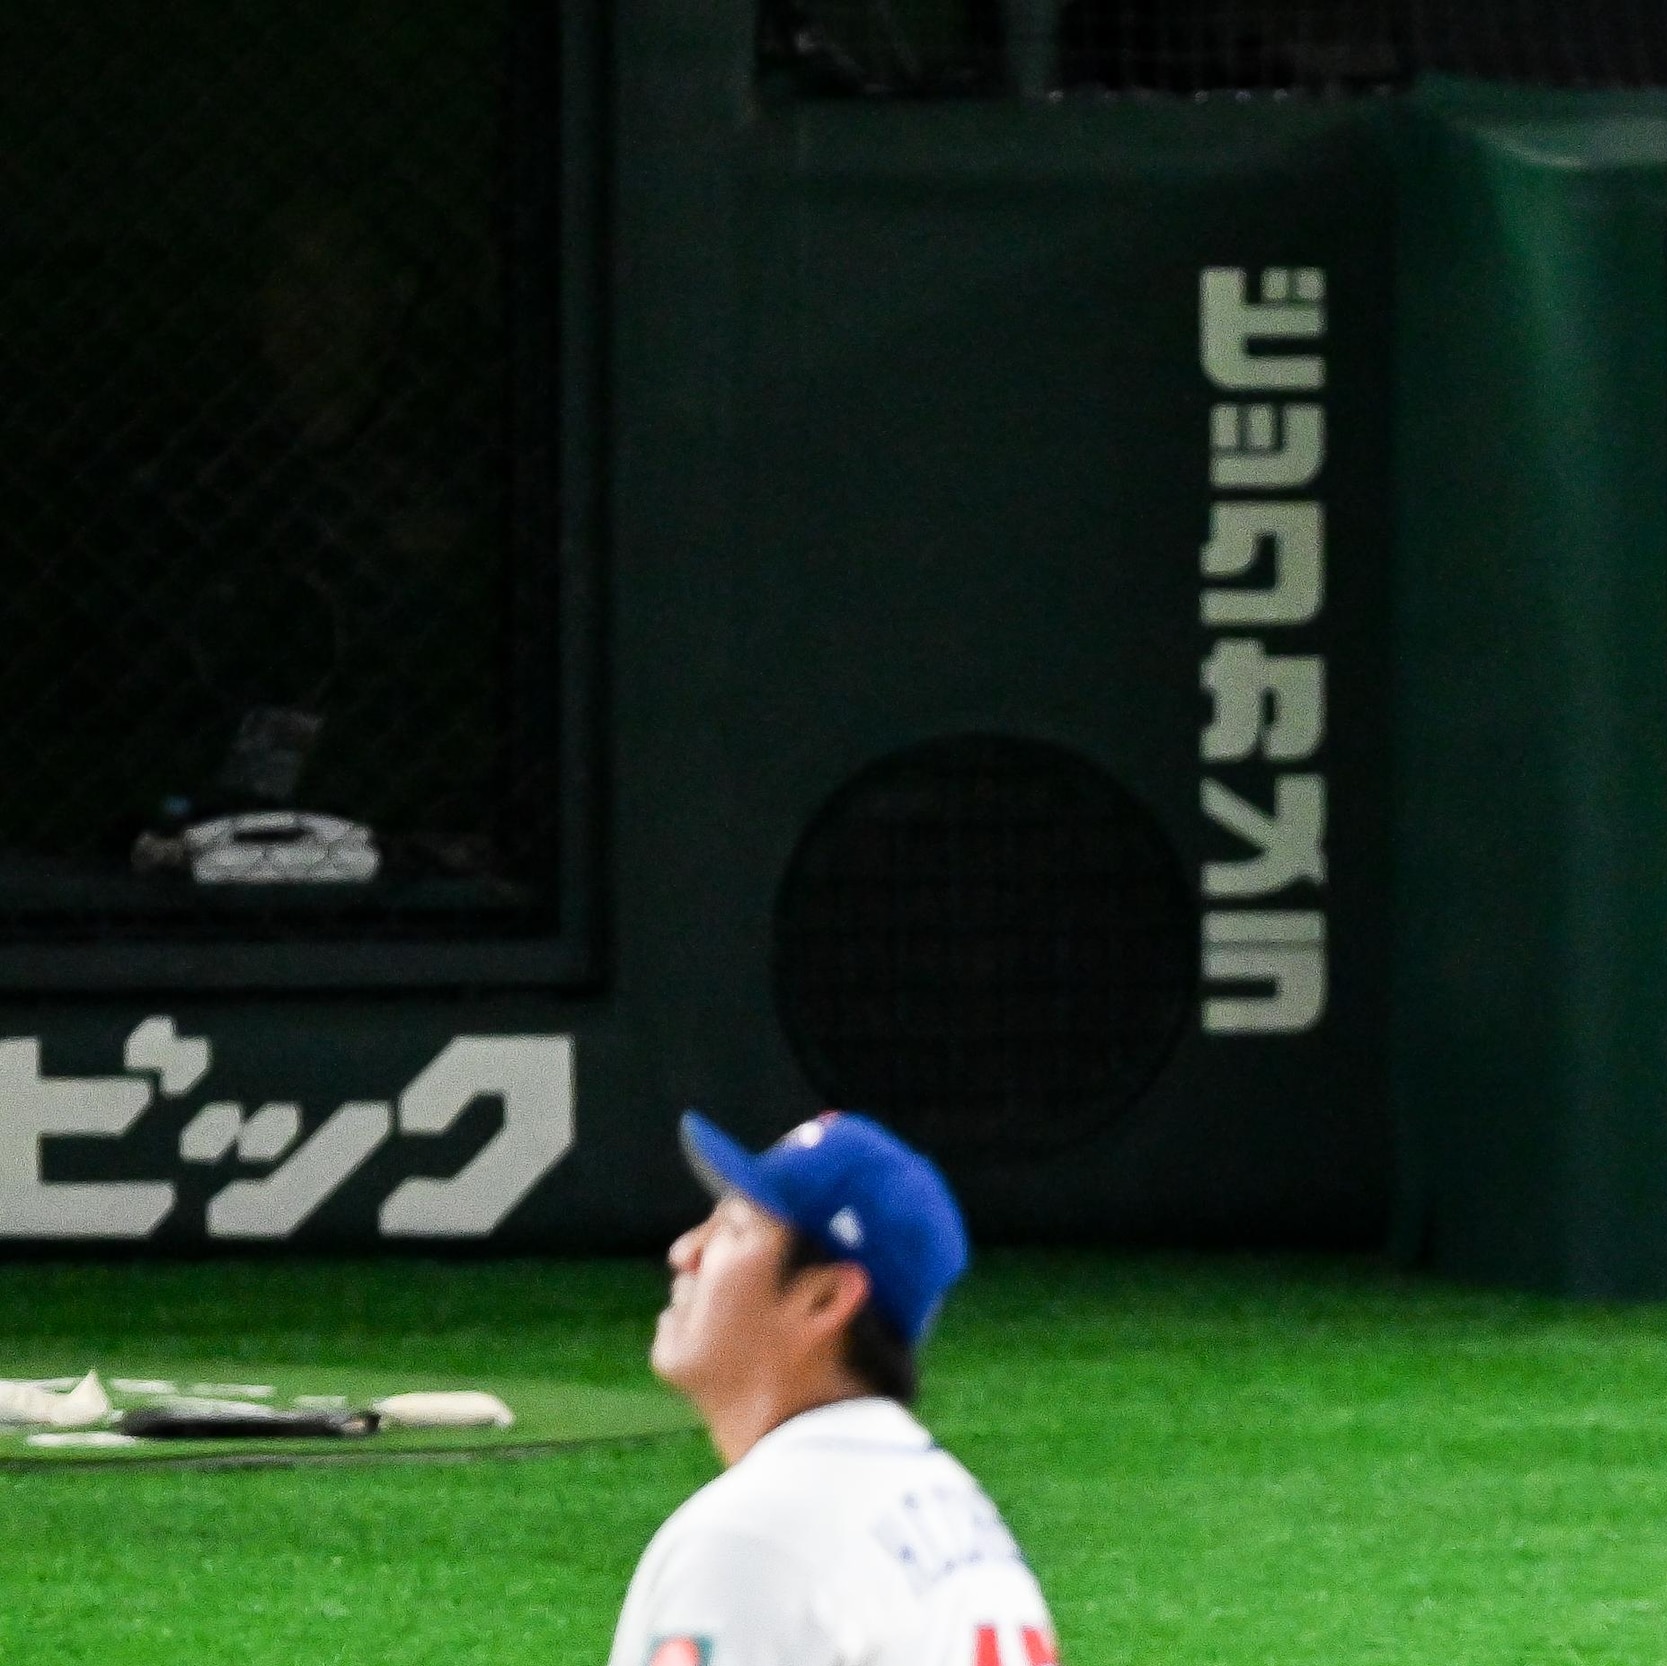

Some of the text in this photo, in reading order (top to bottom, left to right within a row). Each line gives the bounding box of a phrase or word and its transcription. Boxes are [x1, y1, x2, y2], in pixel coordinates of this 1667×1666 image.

[1201, 266, 1327, 1036] ビックカメラ
[0, 1015, 575, 1238] ビック
